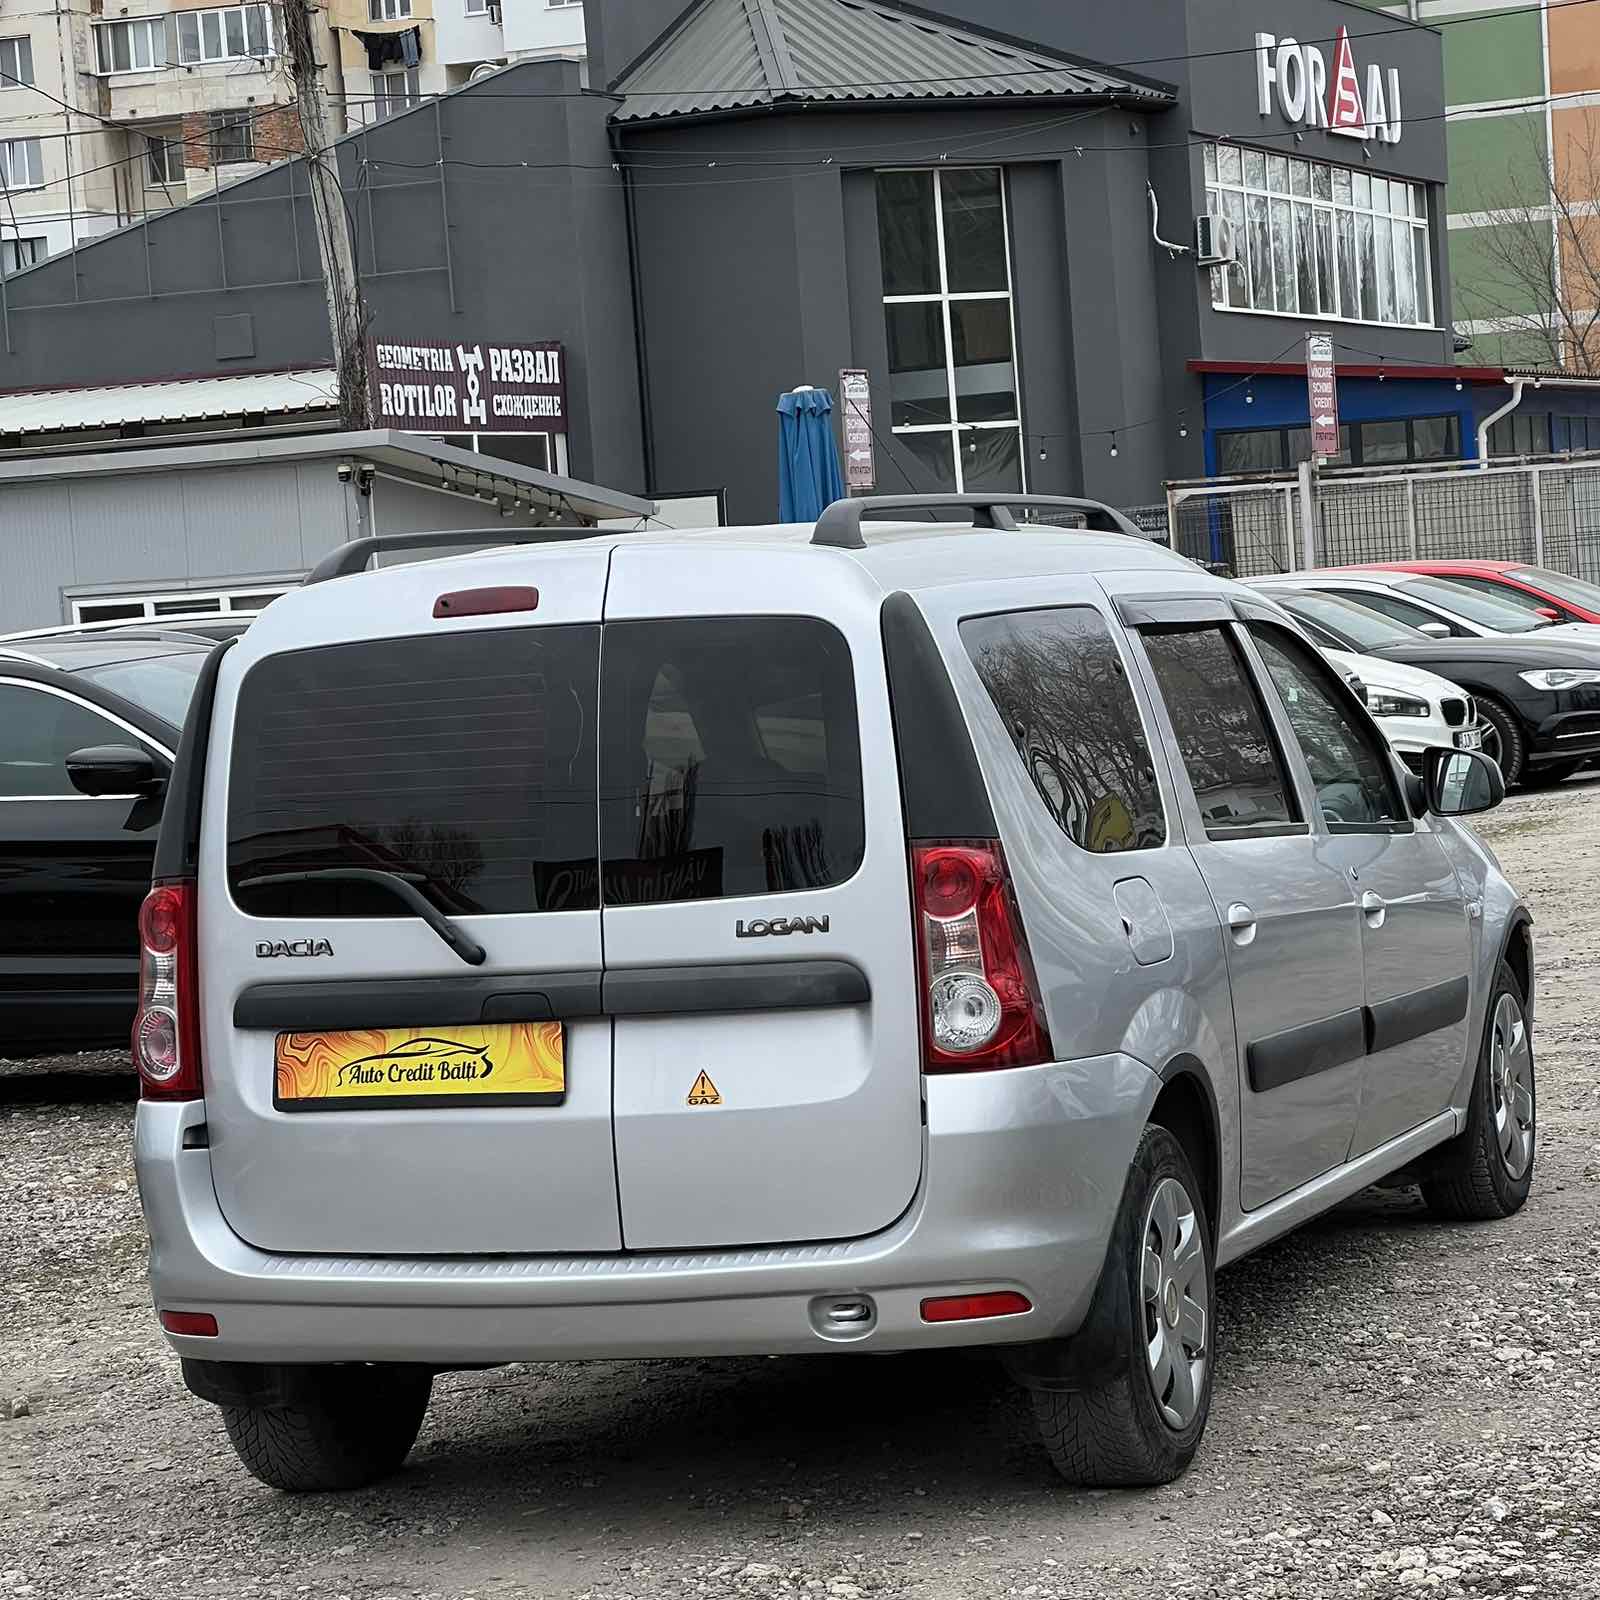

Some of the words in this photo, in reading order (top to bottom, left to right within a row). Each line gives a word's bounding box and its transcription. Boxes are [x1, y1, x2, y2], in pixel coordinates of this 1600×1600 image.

[376, 344, 454, 372] GEOMETRIA
[488, 348, 561, 384] РАЗВАЛ
[379, 383, 458, 417] ROTILOR
[492, 394, 562, 419] СХОЖДЕНИЕ
[1313, 397, 1333, 409] CREDIT
[736, 915, 829, 938] LOGAN
[255, 938, 334, 957] DACIA
[349, 1064, 384, 1084] Auto
[388, 1062, 435, 1082] Credit
[687, 1097, 721, 1105] GAZ
